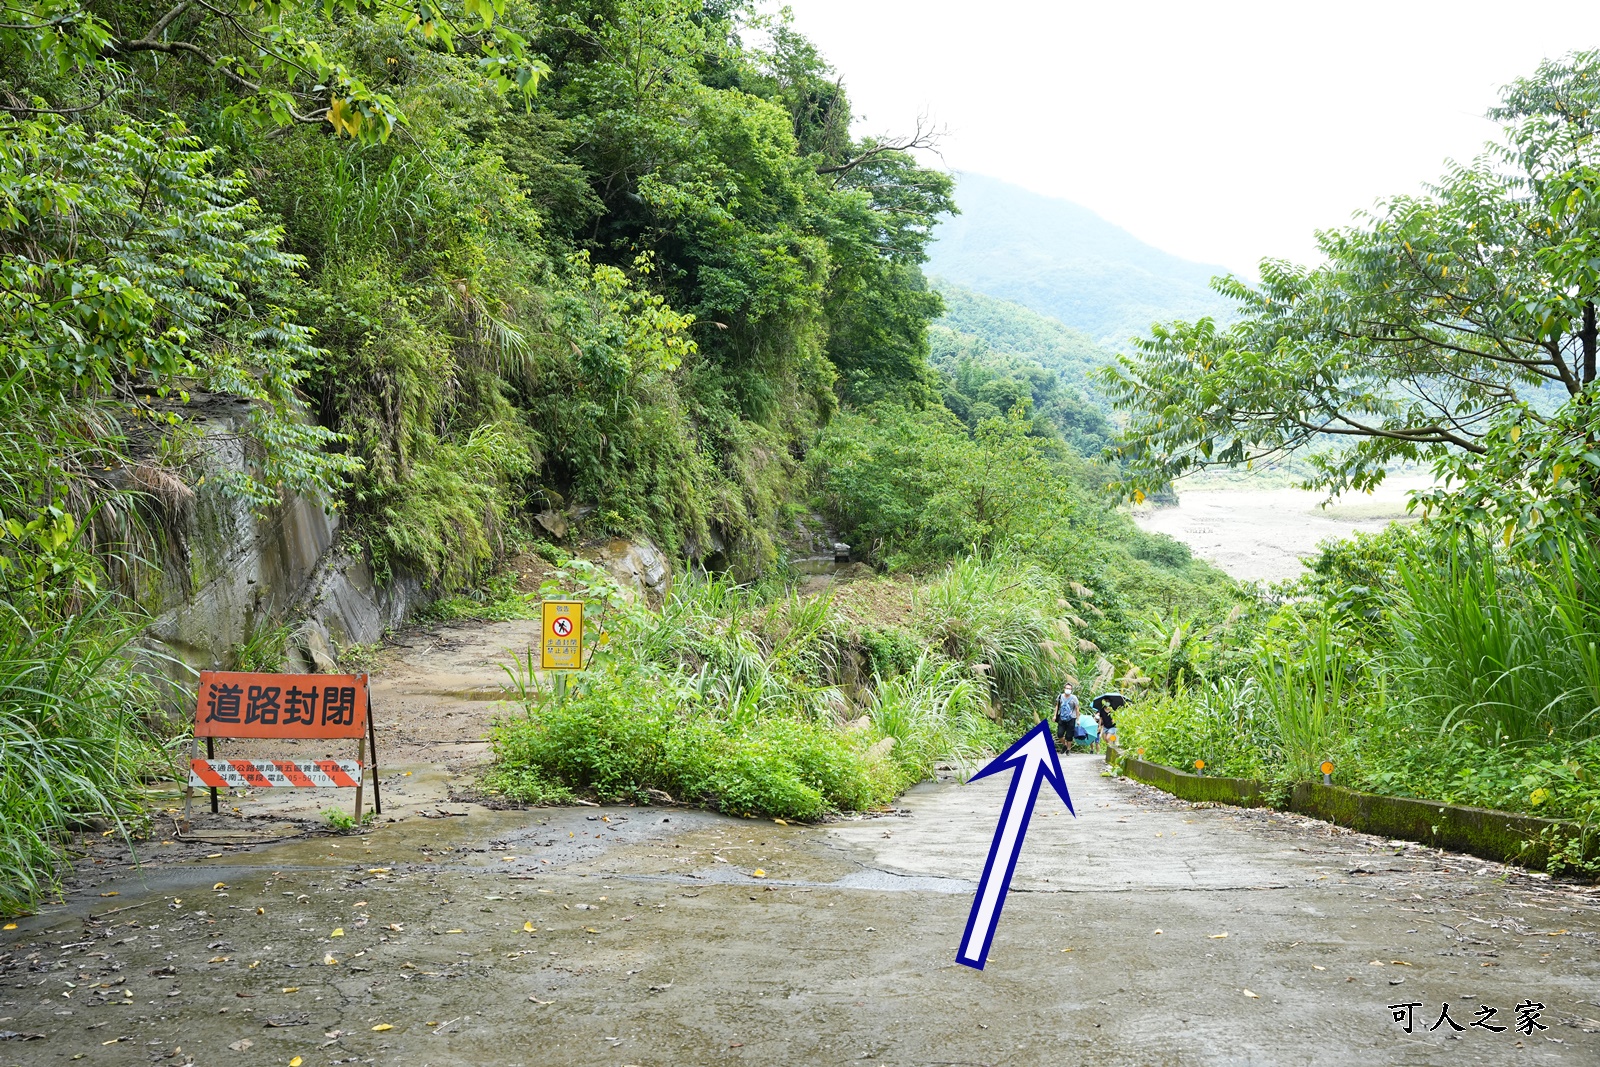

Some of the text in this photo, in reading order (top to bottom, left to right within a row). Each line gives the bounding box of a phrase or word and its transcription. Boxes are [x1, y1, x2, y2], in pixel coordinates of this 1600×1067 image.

[205, 683, 356, 726] 道路封閉
[219, 774, 264, 782] 斗南工務段
[267, 774, 285, 782] 電話
